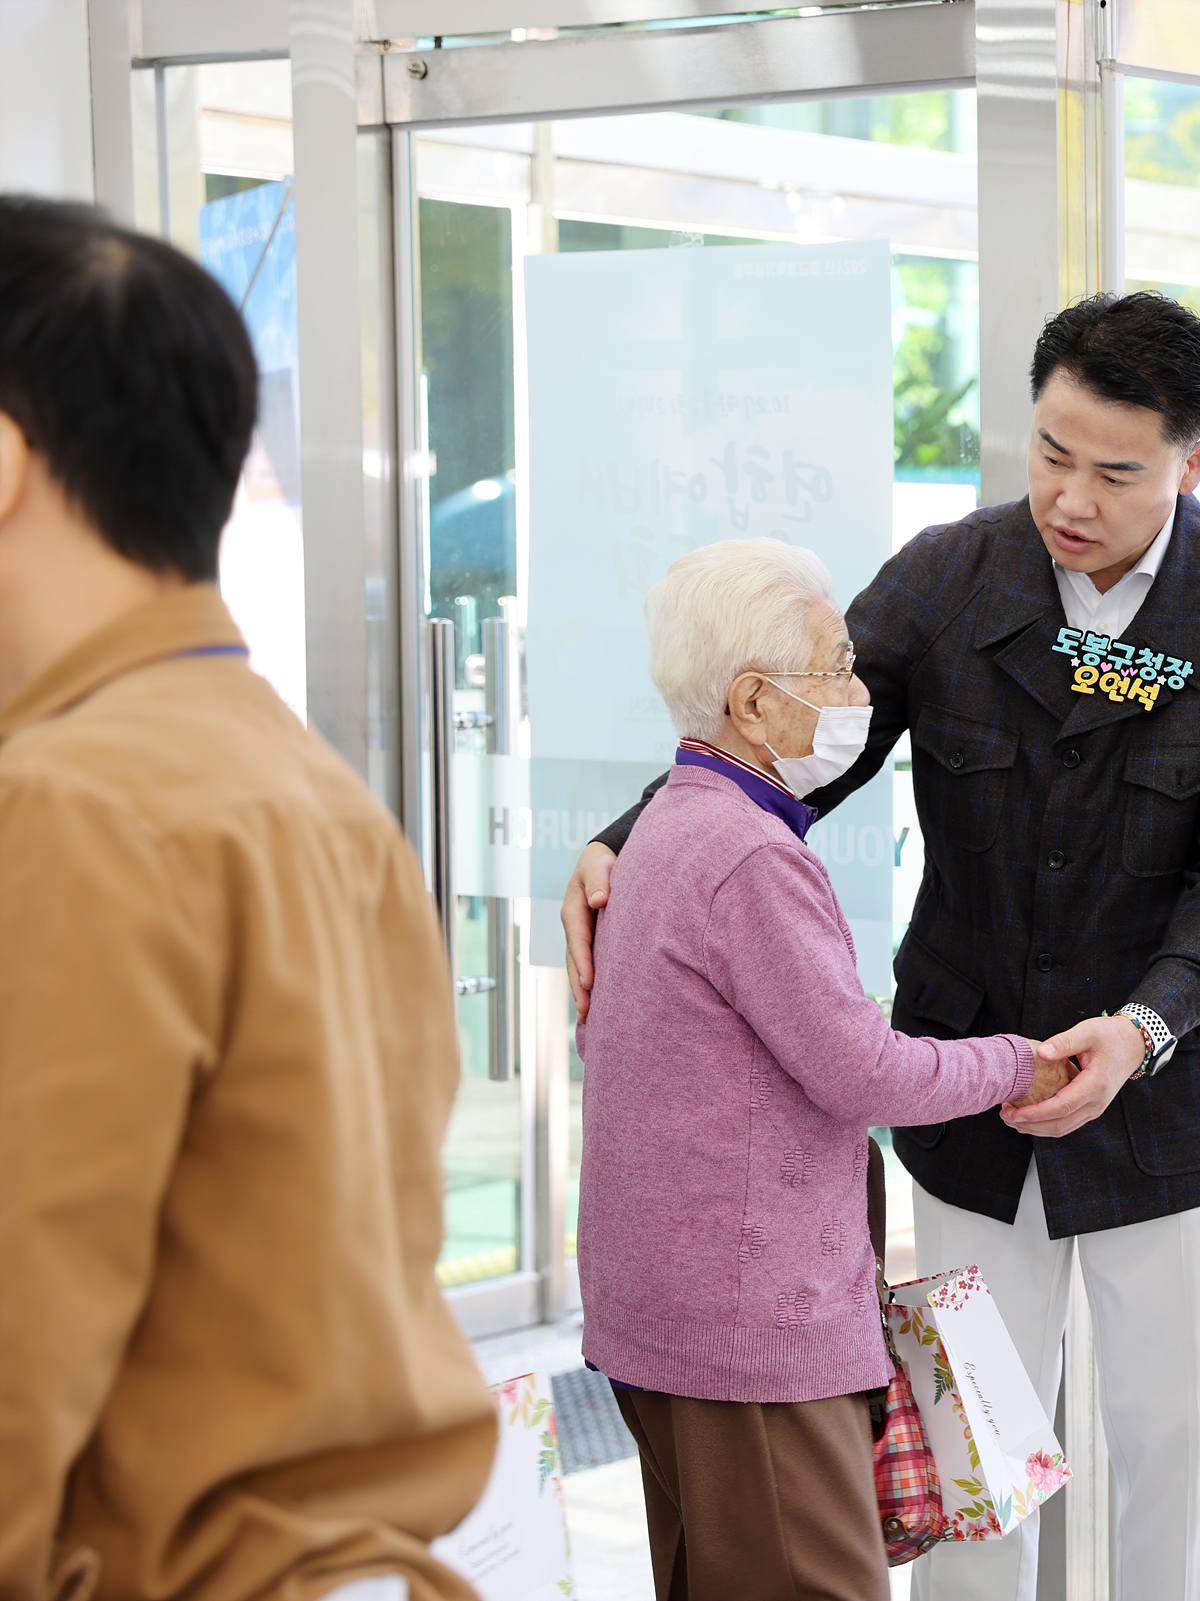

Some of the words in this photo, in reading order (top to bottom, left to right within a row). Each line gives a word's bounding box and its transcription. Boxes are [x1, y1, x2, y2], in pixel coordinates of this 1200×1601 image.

[1051, 626, 1194, 690] 도봉구청장
[1070, 665, 1161, 712] 오연석
[963, 1361, 993, 1417] Especially
[986, 1417, 1001, 1438] you
